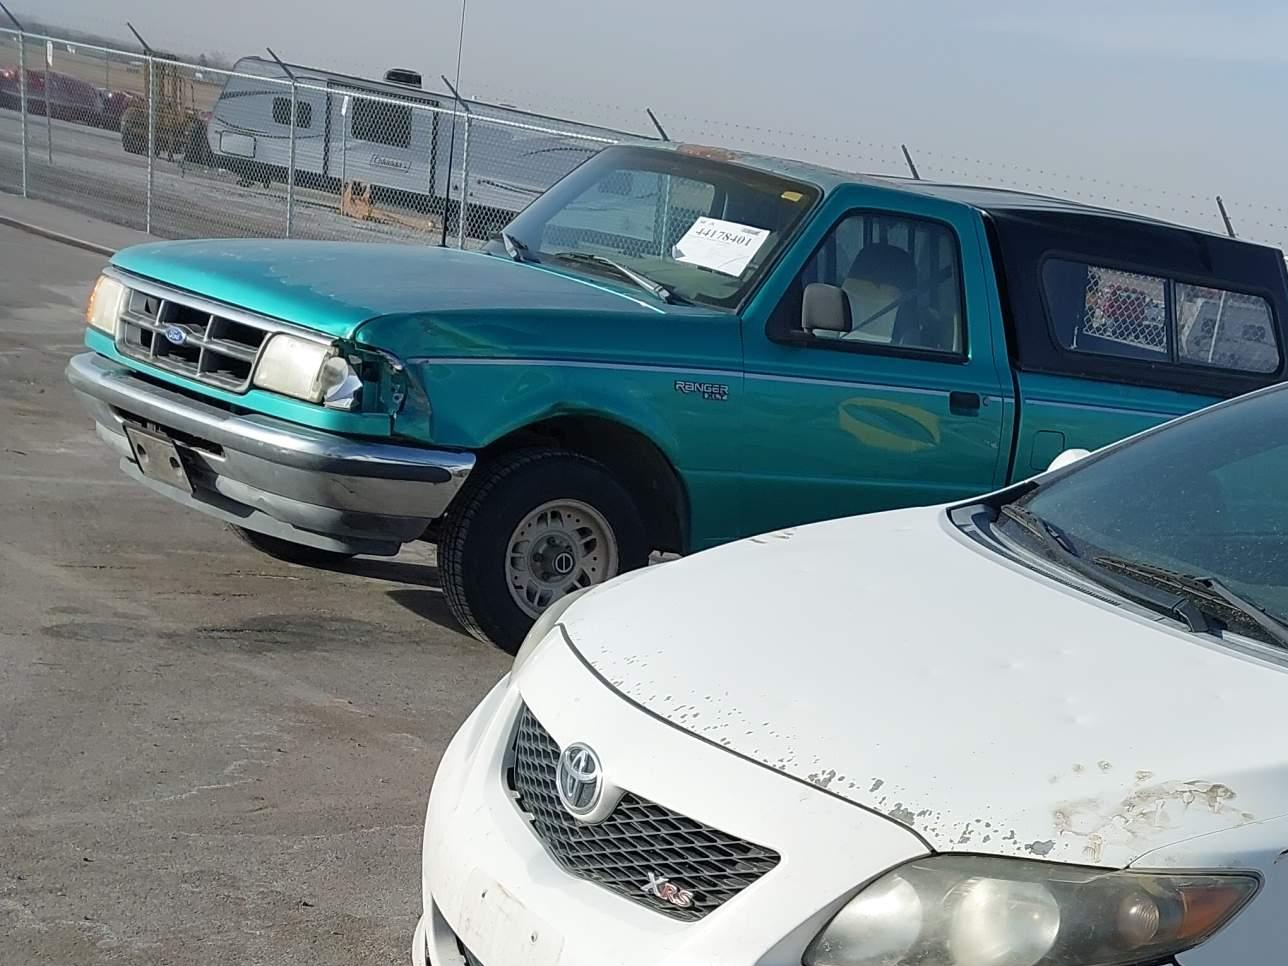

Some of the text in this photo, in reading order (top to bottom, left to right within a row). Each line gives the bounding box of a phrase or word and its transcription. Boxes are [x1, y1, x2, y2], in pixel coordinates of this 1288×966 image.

[696, 227, 752, 247] 44178401
[675, 381, 729, 394] RANGER
[641, 871, 694, 908] XRS
